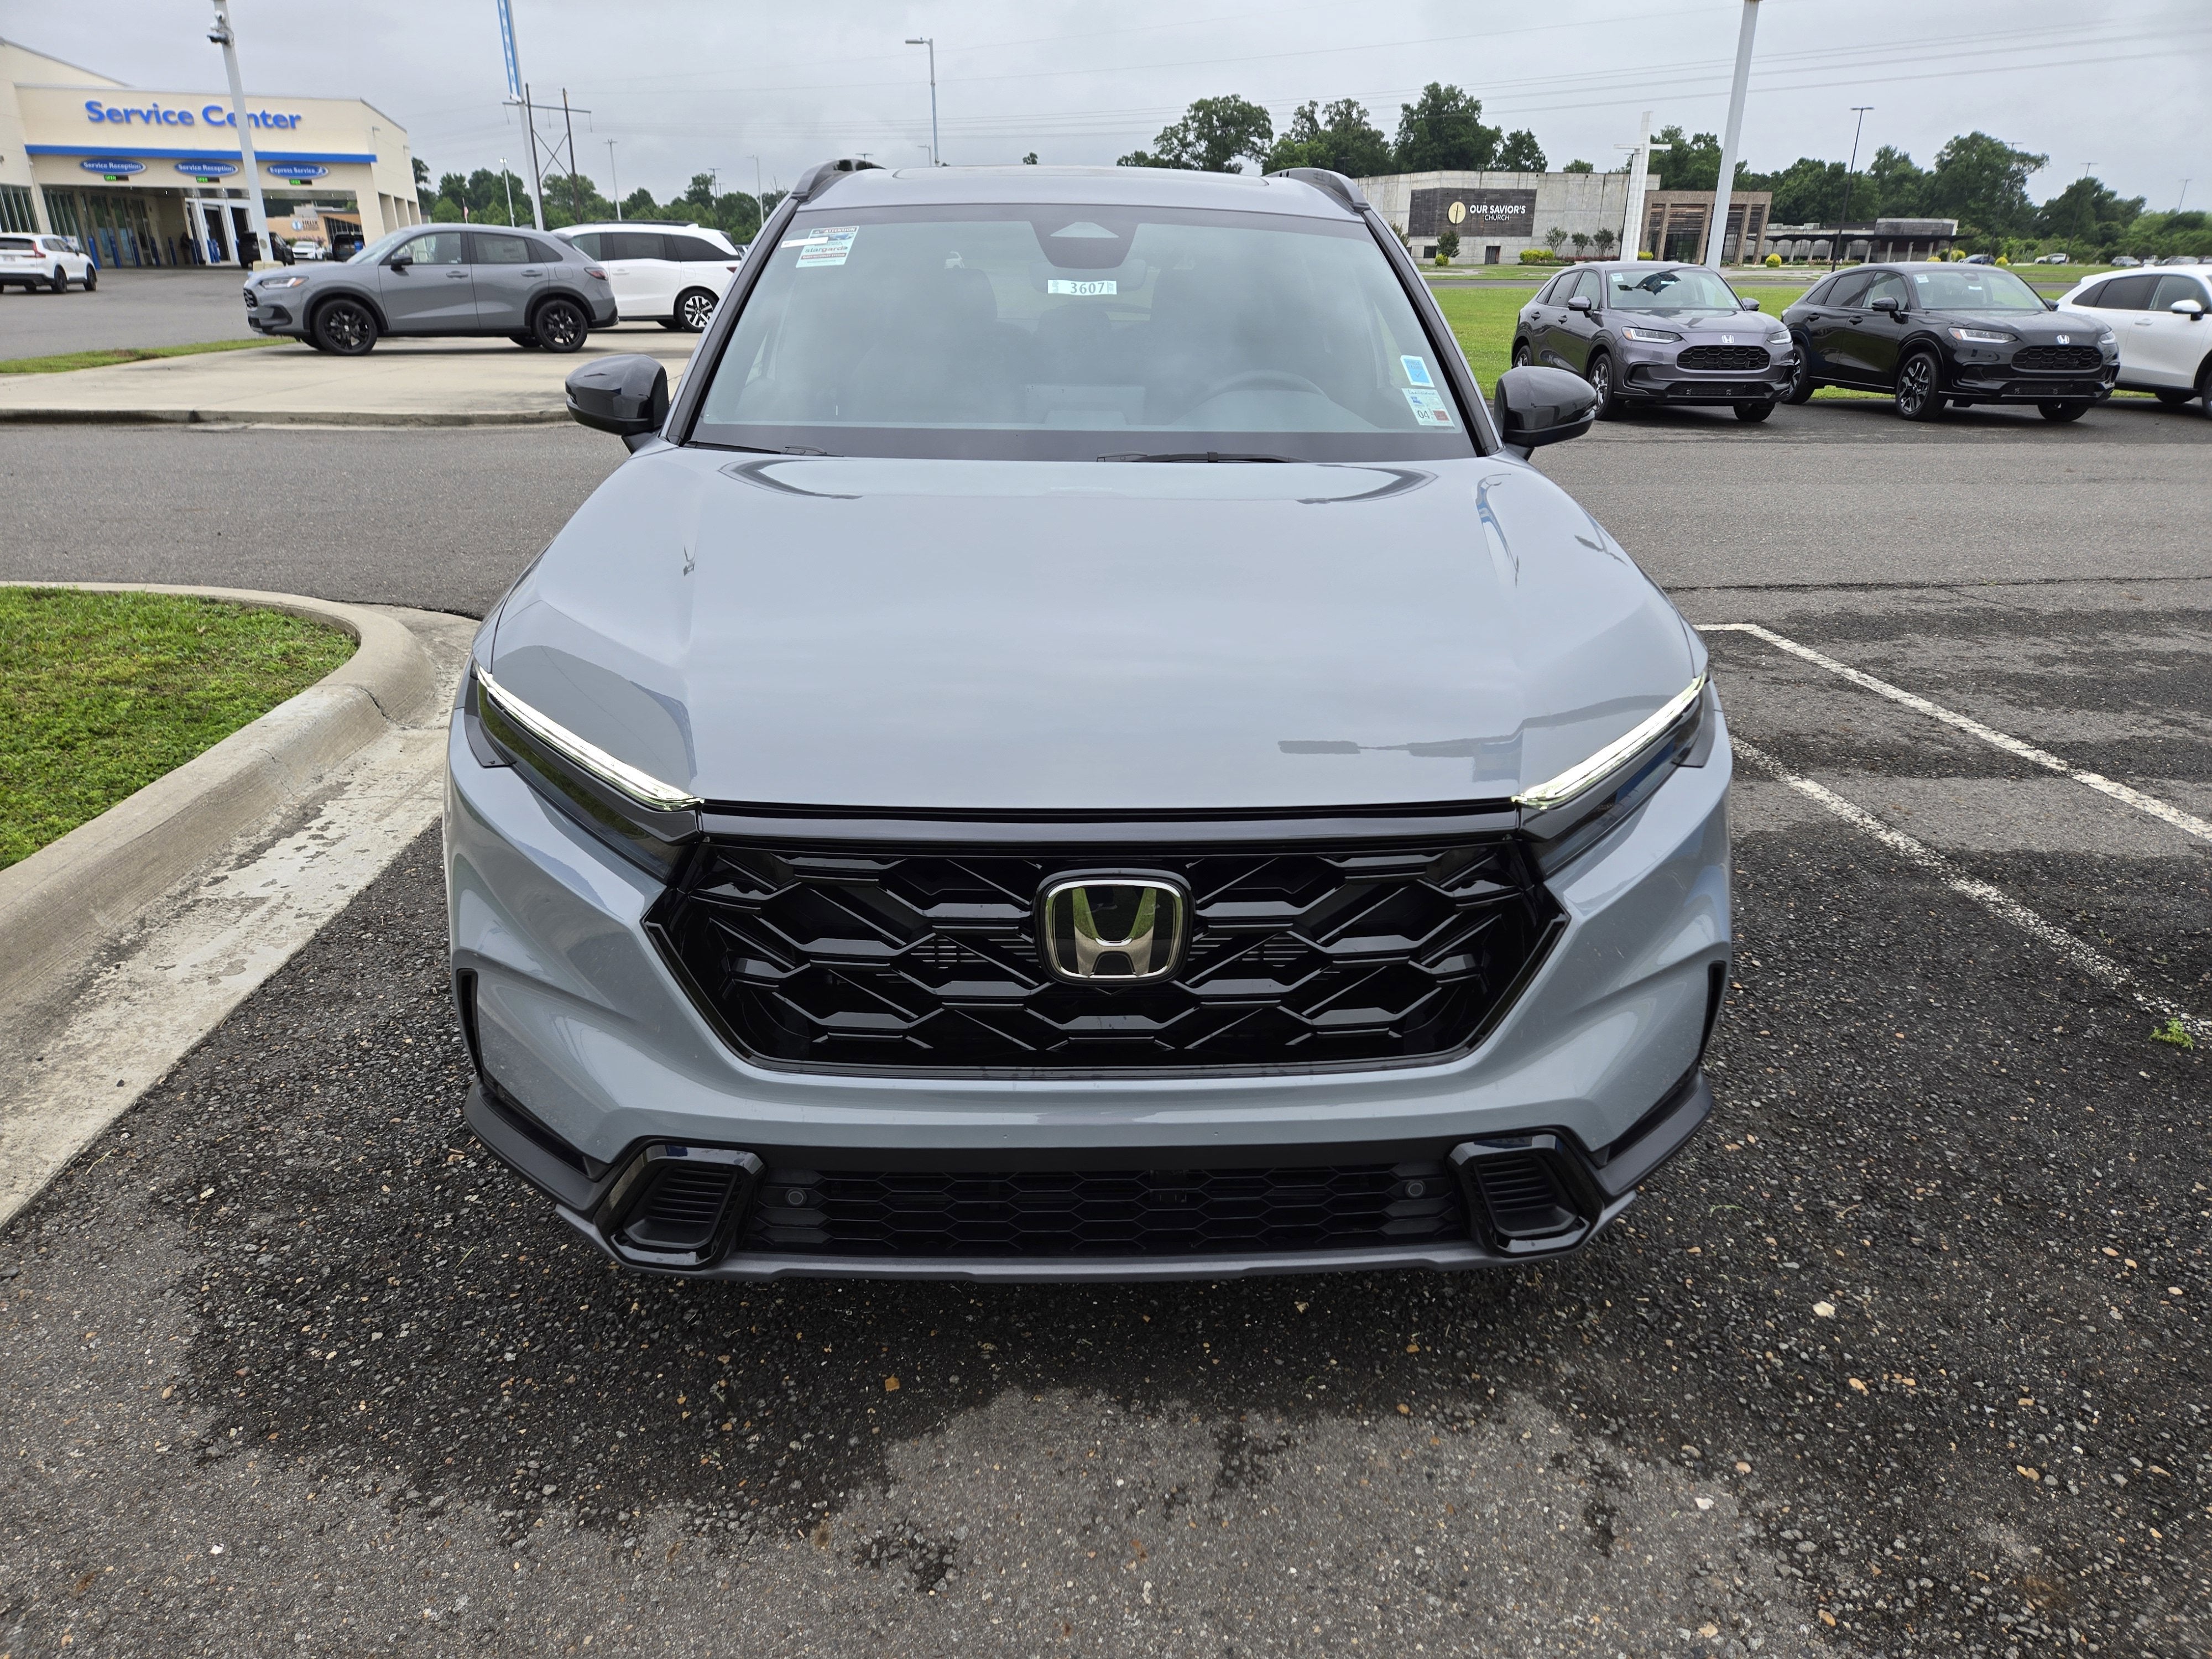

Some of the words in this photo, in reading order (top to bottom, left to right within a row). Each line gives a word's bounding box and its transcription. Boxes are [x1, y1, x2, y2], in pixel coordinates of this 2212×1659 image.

[85, 101, 194, 126] Service
[202, 105, 301, 129] Center
[109, 162, 141, 170] Reception
[202, 164, 233, 173] Reception
[1469, 205, 1488, 214] OUR
[1489, 205, 1526, 215] SAVIOR'S
[1070, 281, 1105, 294] 3607
[1417, 410, 1430, 419] 04
